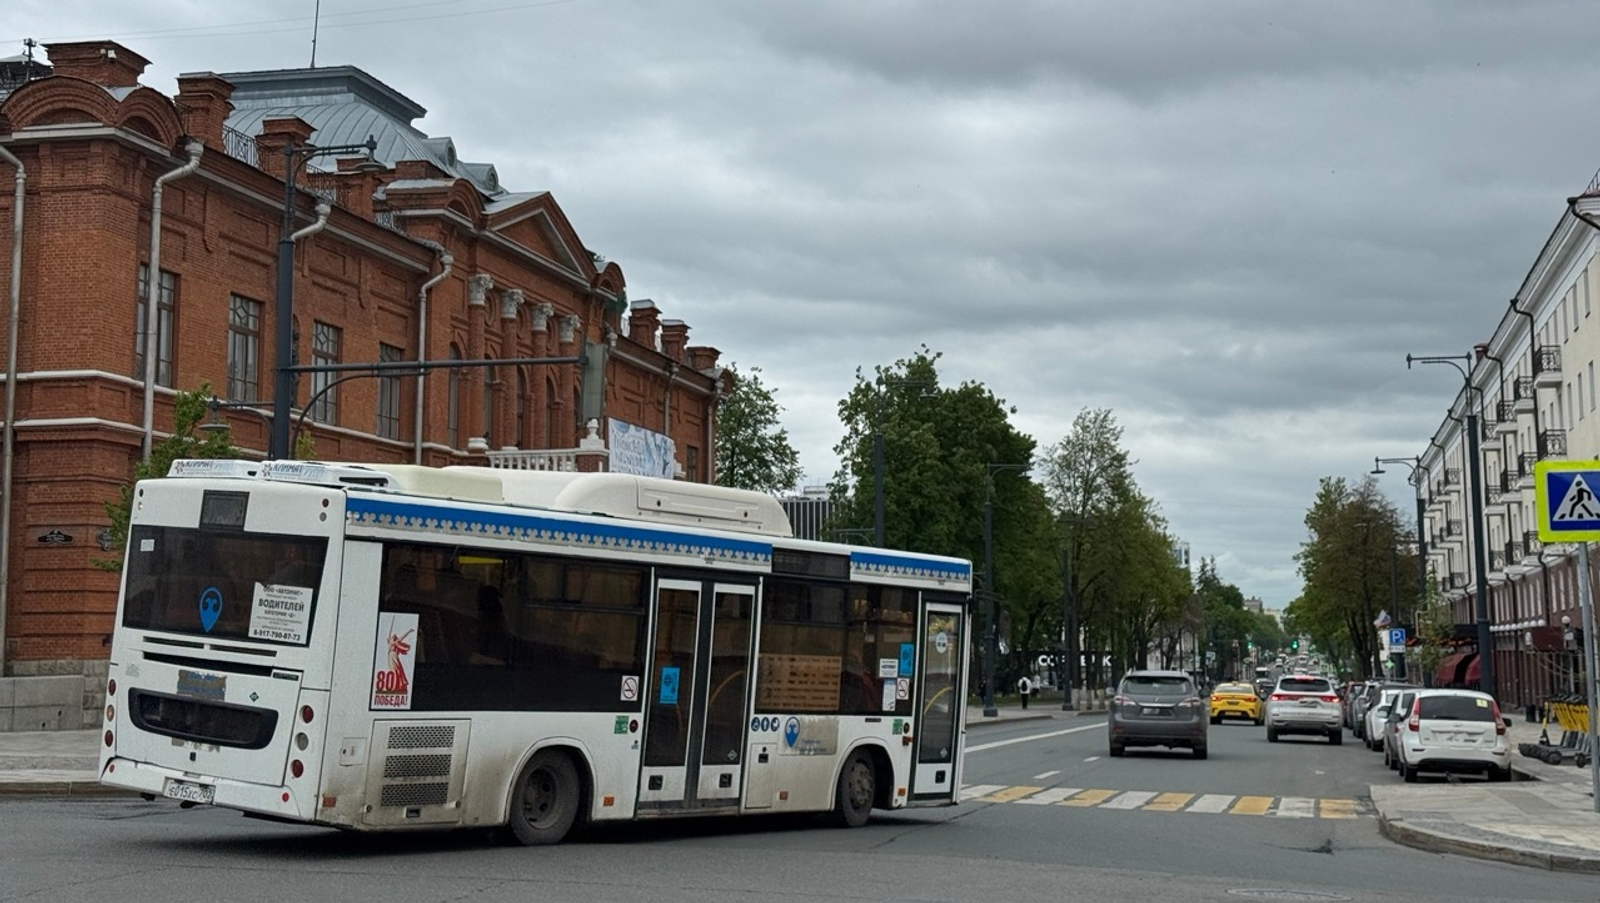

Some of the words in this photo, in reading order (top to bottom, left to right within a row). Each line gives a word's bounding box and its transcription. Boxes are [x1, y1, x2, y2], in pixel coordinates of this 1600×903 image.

[258, 598, 305, 612] ВОДИТЕЛЕЙ
[253, 629, 301, 641] 8-917-790-87-73
[376, 670, 395, 691] 80
[373, 694, 408, 707] ПОБЕДА!
